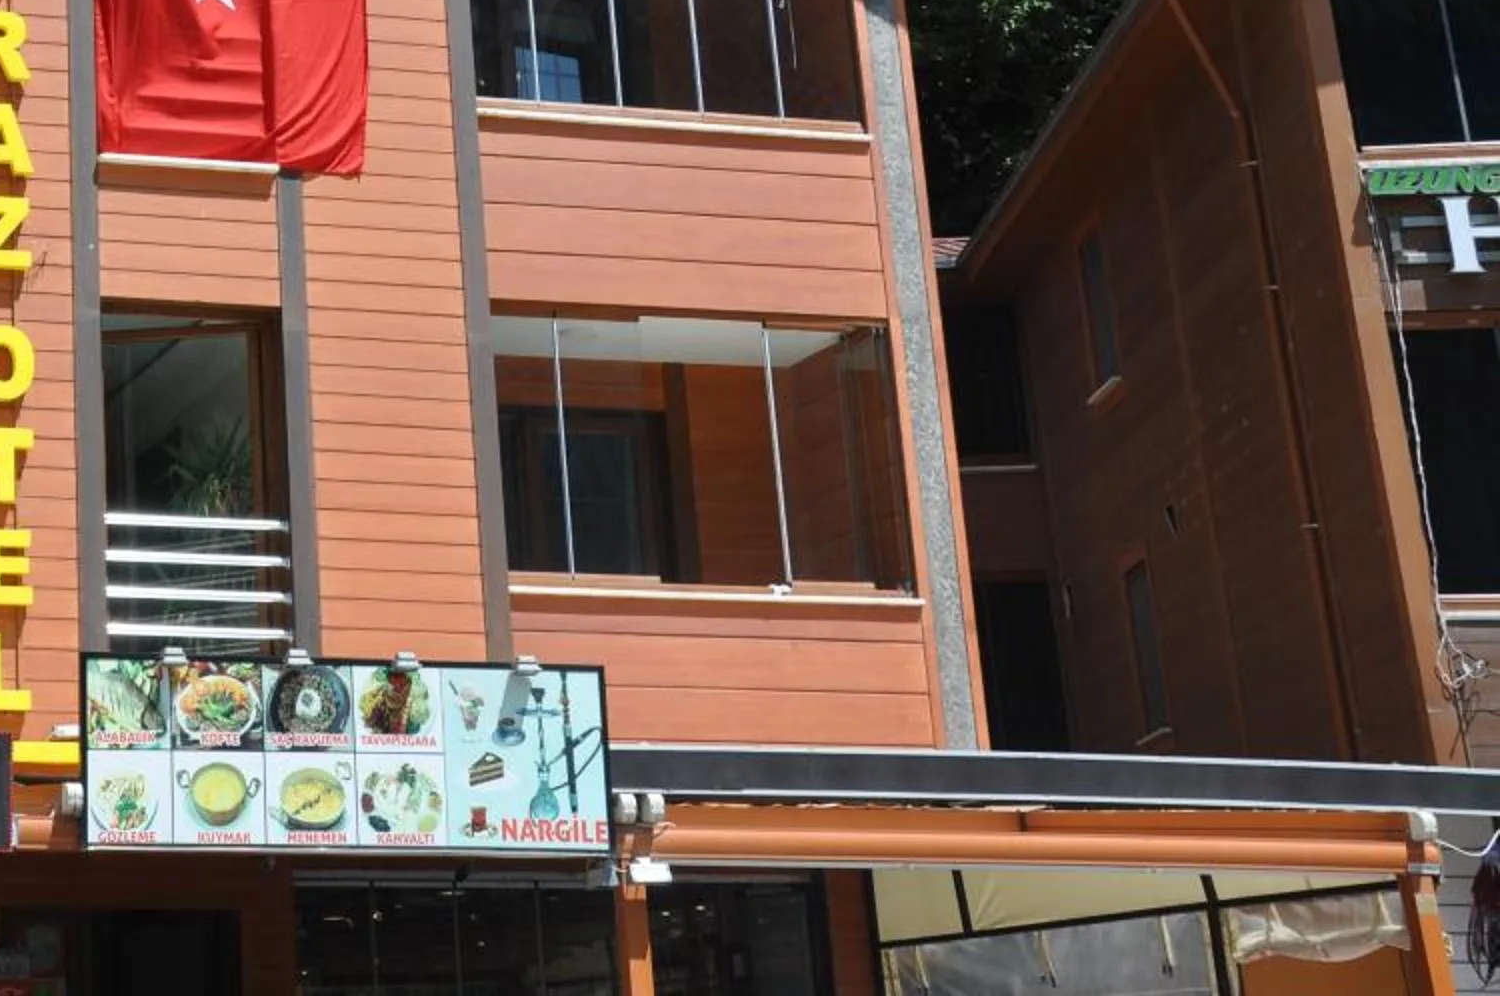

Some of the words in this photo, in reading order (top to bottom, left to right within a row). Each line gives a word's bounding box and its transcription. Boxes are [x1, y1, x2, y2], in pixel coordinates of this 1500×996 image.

[501, 815, 609, 845] NARGİLE
[287, 832, 347, 844] MENEMEN
[376, 833, 435, 845] KAHVALTI
